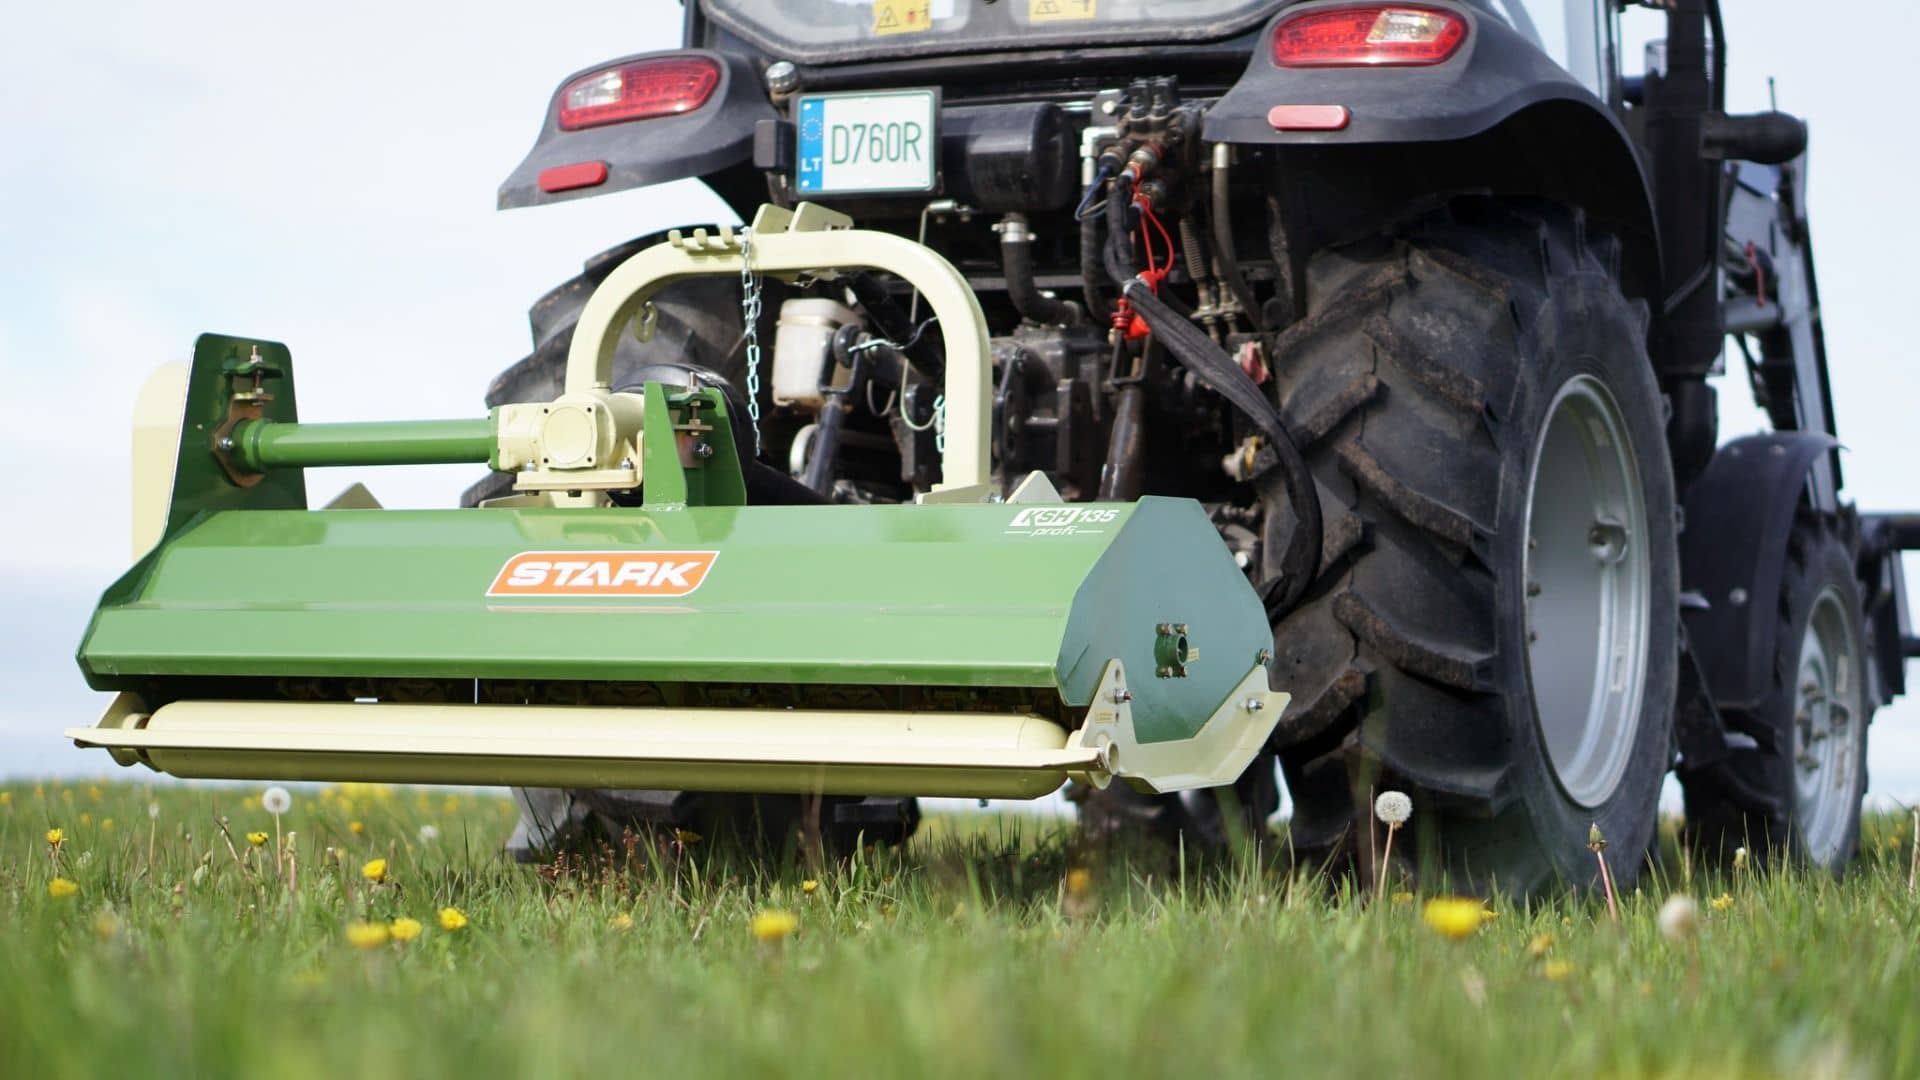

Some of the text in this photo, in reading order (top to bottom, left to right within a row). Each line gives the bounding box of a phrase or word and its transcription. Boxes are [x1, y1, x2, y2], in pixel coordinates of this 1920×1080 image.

[831, 121, 922, 165] D760R
[801, 157, 822, 172] LT
[1012, 507, 1120, 526] KSH 135
[1030, 525, 1078, 537] profi
[506, 561, 703, 587] STARK
